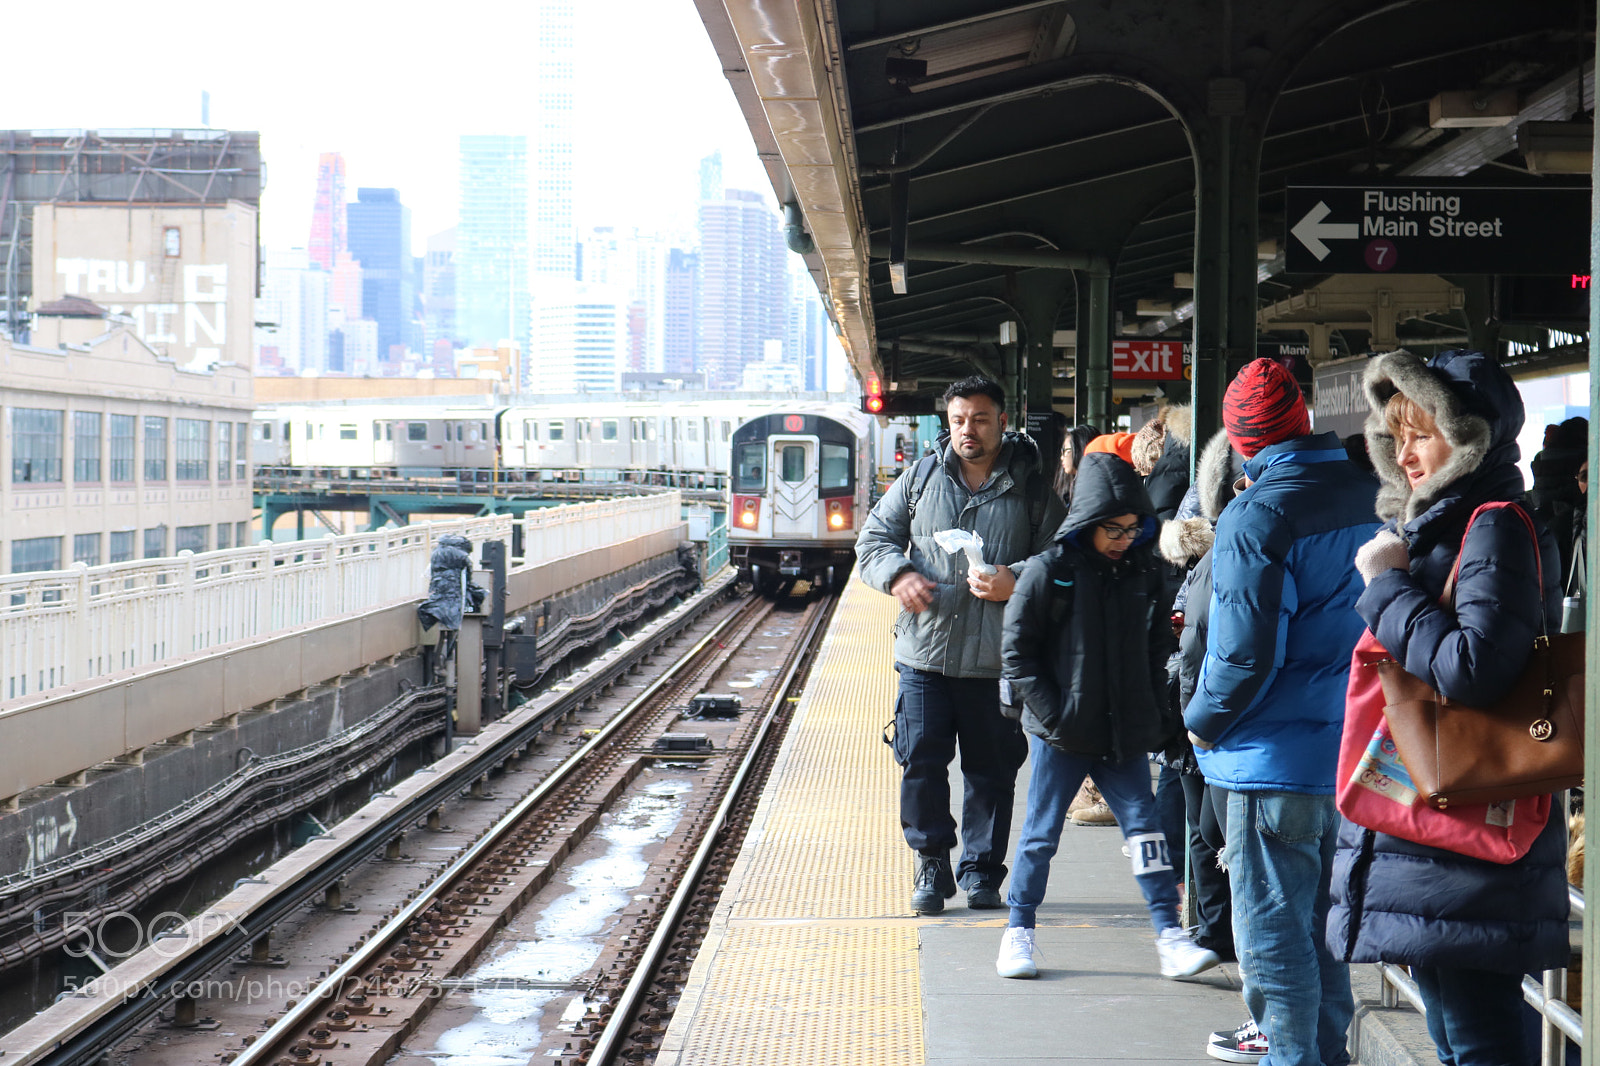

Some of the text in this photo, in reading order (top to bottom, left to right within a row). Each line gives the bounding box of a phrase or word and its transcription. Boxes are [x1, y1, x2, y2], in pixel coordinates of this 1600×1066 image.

[1364, 191, 1460, 216] Flushing
[1363, 216, 1503, 237] Main Street
[1374, 247, 1389, 265] 7
[1113, 342, 1173, 373] Exit
[1533, 723, 1549, 736] MK
